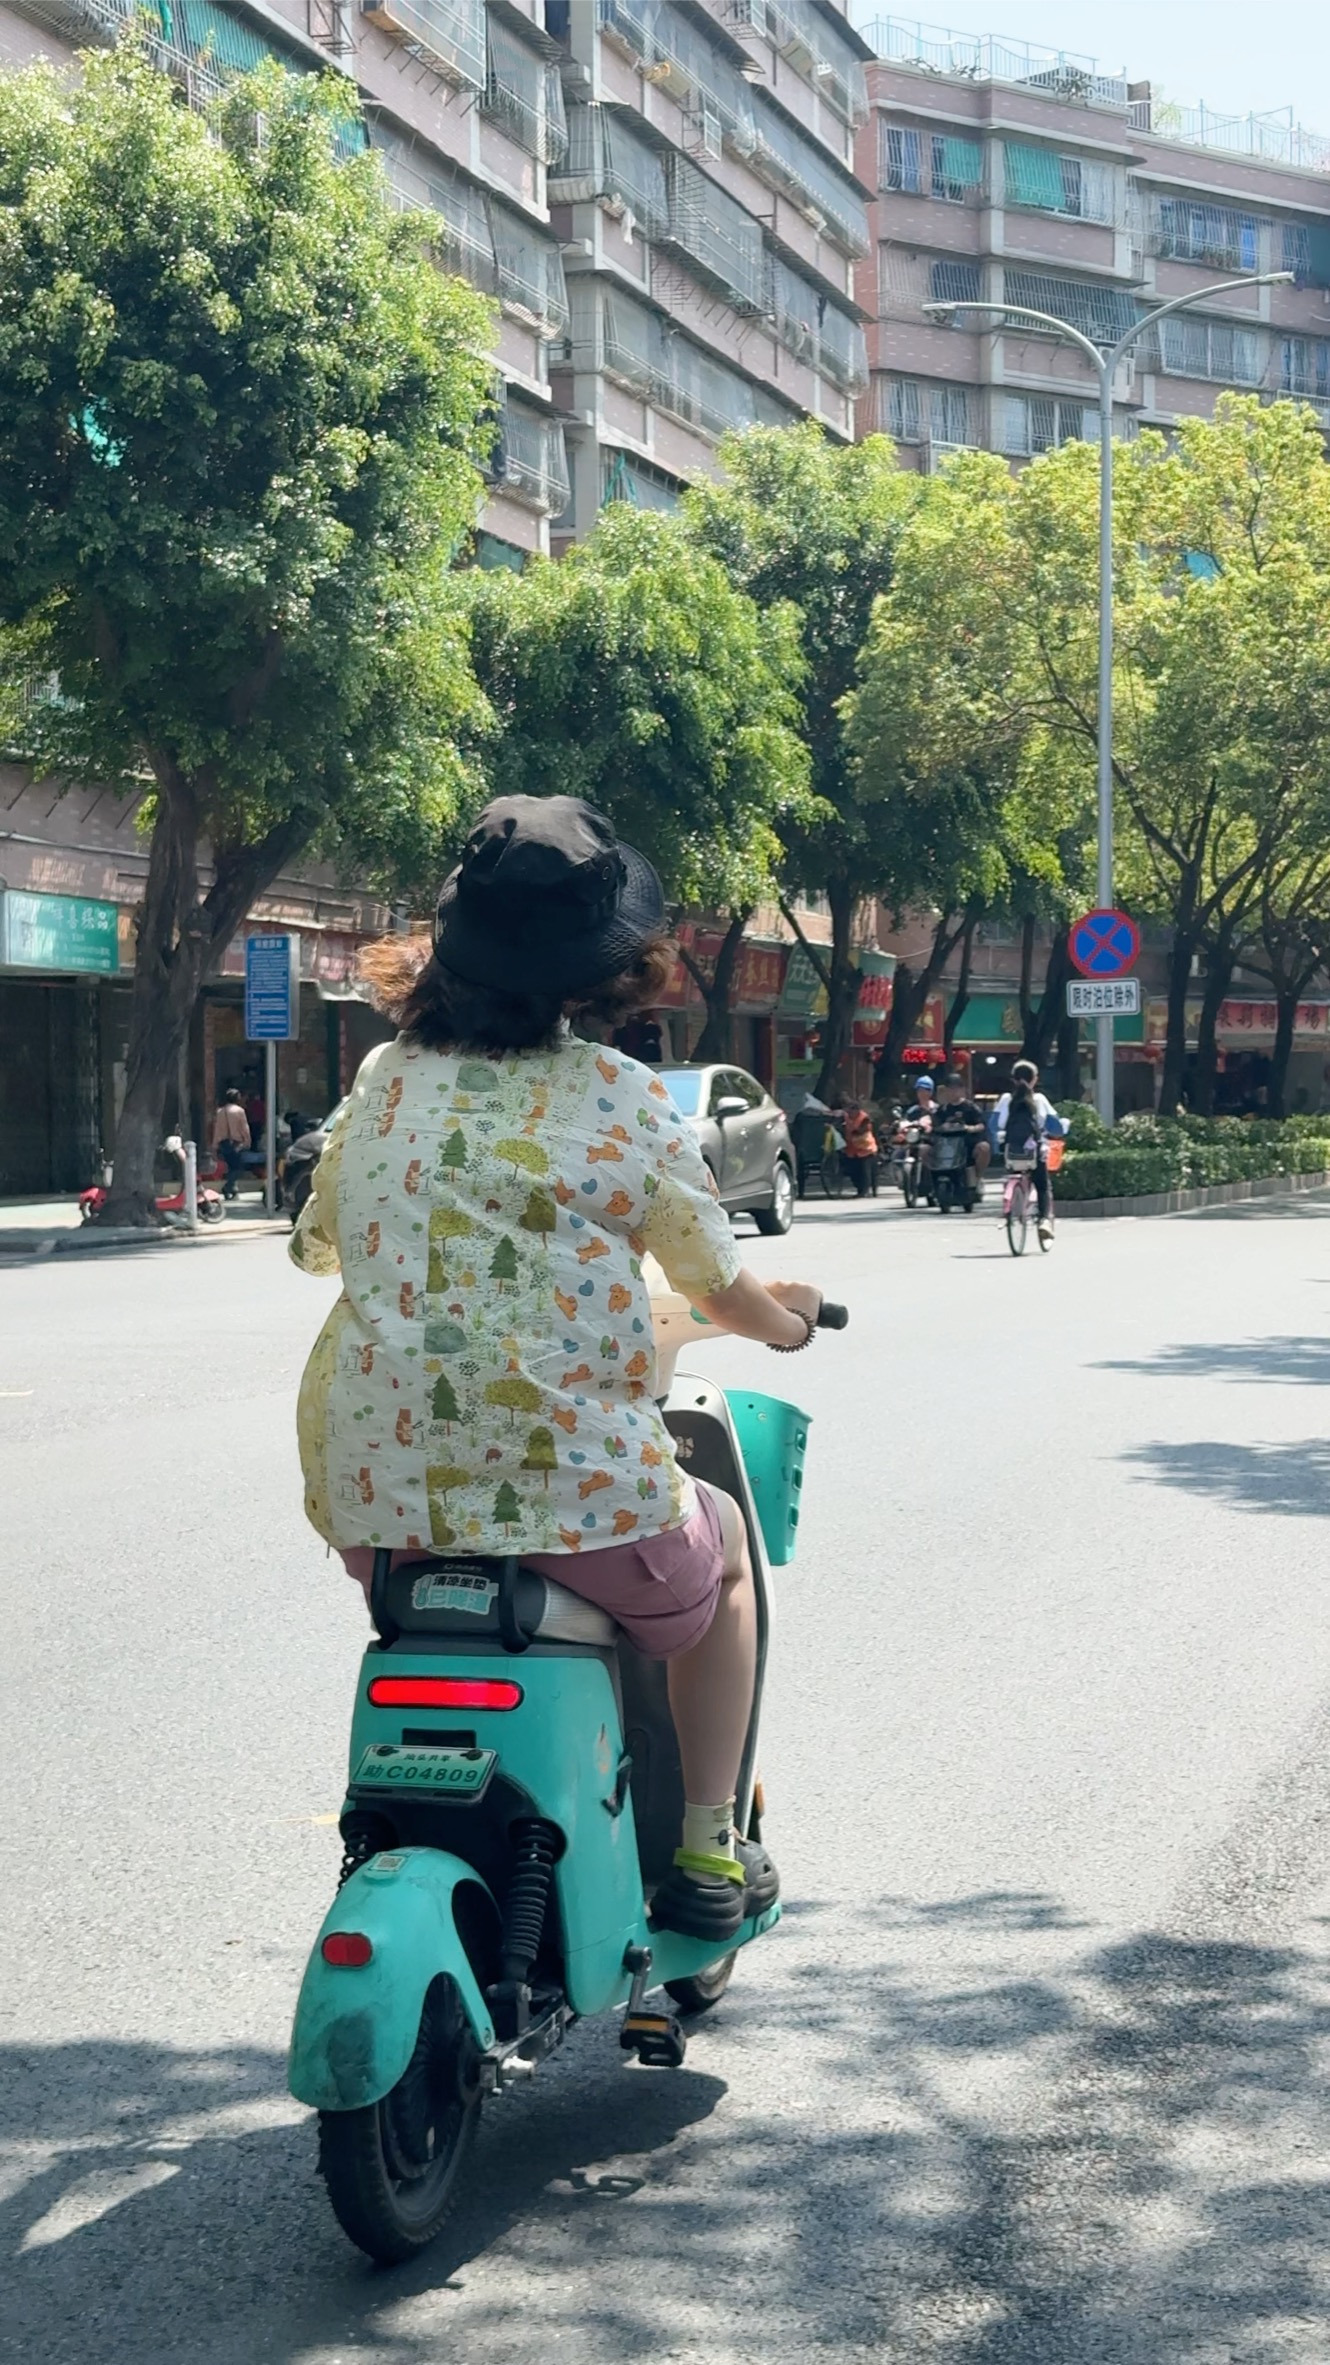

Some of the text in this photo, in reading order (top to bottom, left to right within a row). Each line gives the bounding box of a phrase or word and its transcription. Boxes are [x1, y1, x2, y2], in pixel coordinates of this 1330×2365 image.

[1072, 984, 1134, 1009] 限时泊位除外
[432, 1575, 488, 1591] 清凉坐垫
[362, 1764, 478, 1782] 助C04809
